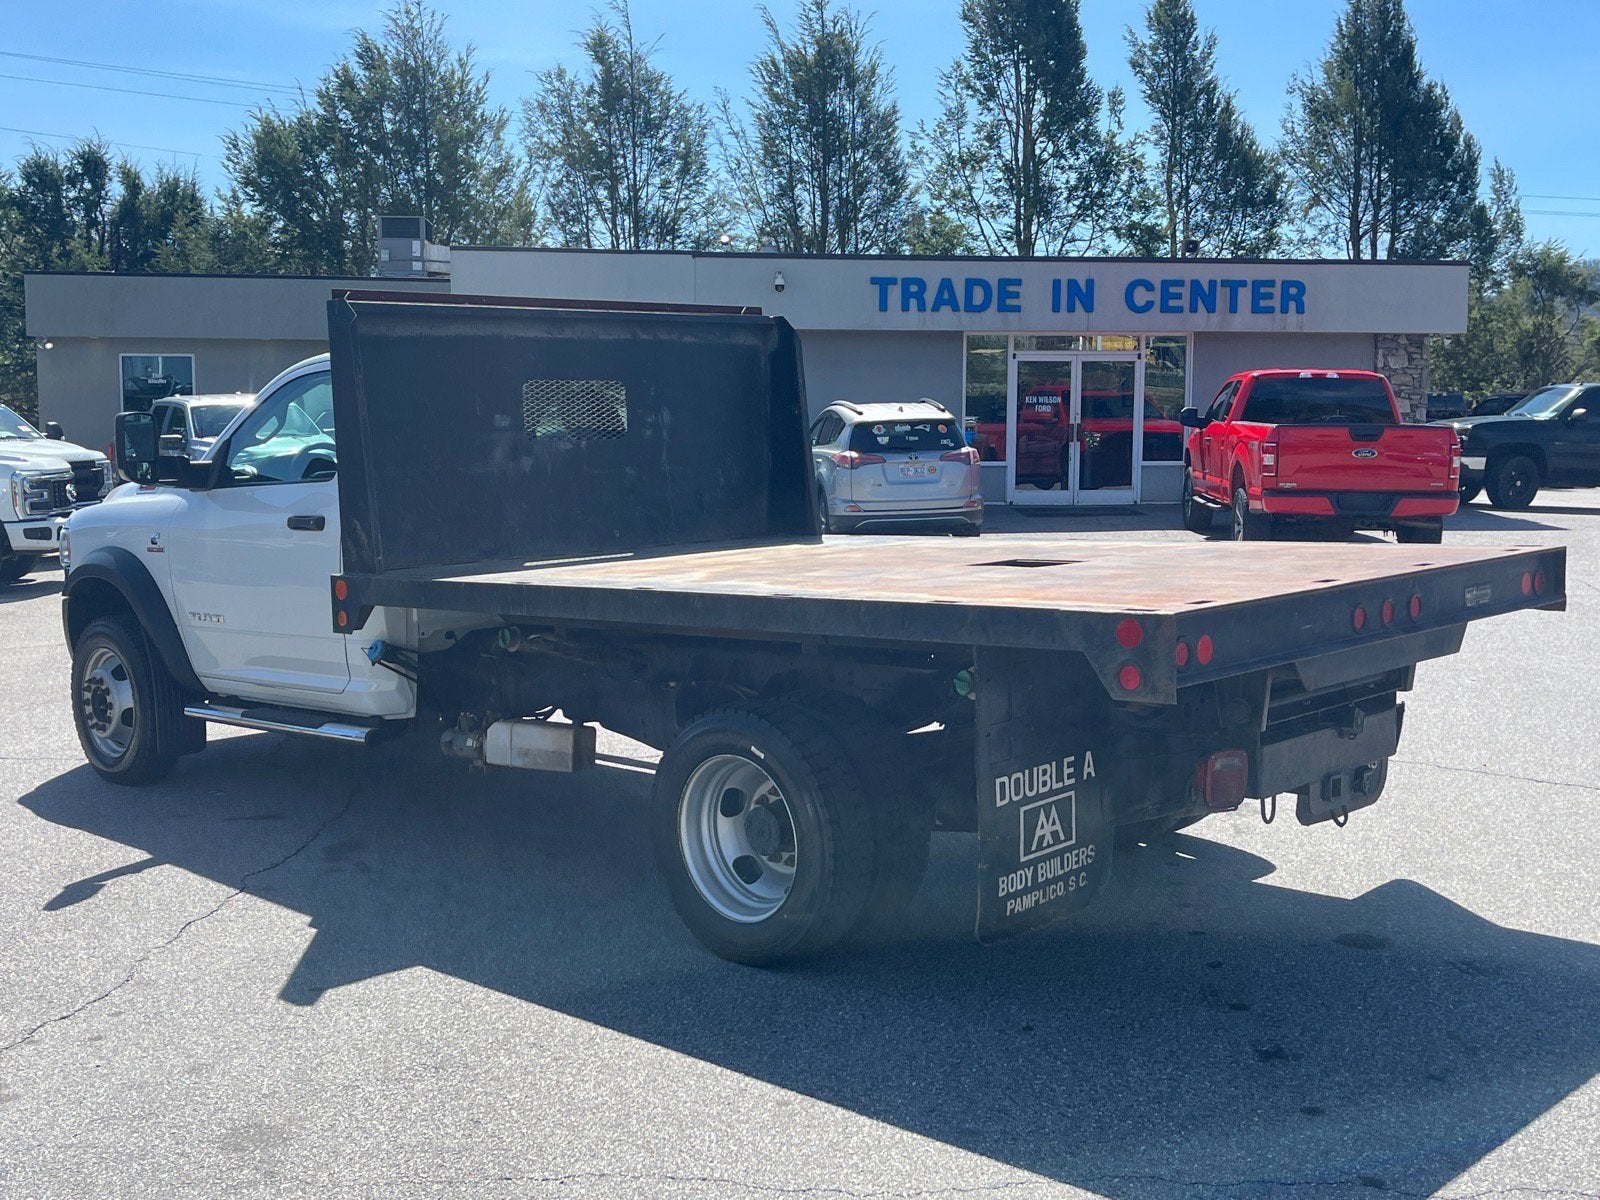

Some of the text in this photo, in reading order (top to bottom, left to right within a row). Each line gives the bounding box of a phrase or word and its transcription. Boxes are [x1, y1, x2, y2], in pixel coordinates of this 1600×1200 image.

[870, 276, 1307, 314] TRADE IN CENTER
[1025, 396, 1061, 404] KEN WILSON
[1035, 404, 1052, 412] FORD
[995, 751, 1096, 807] DOUBLE A
[998, 844, 1096, 897] BODY BUILDERS
